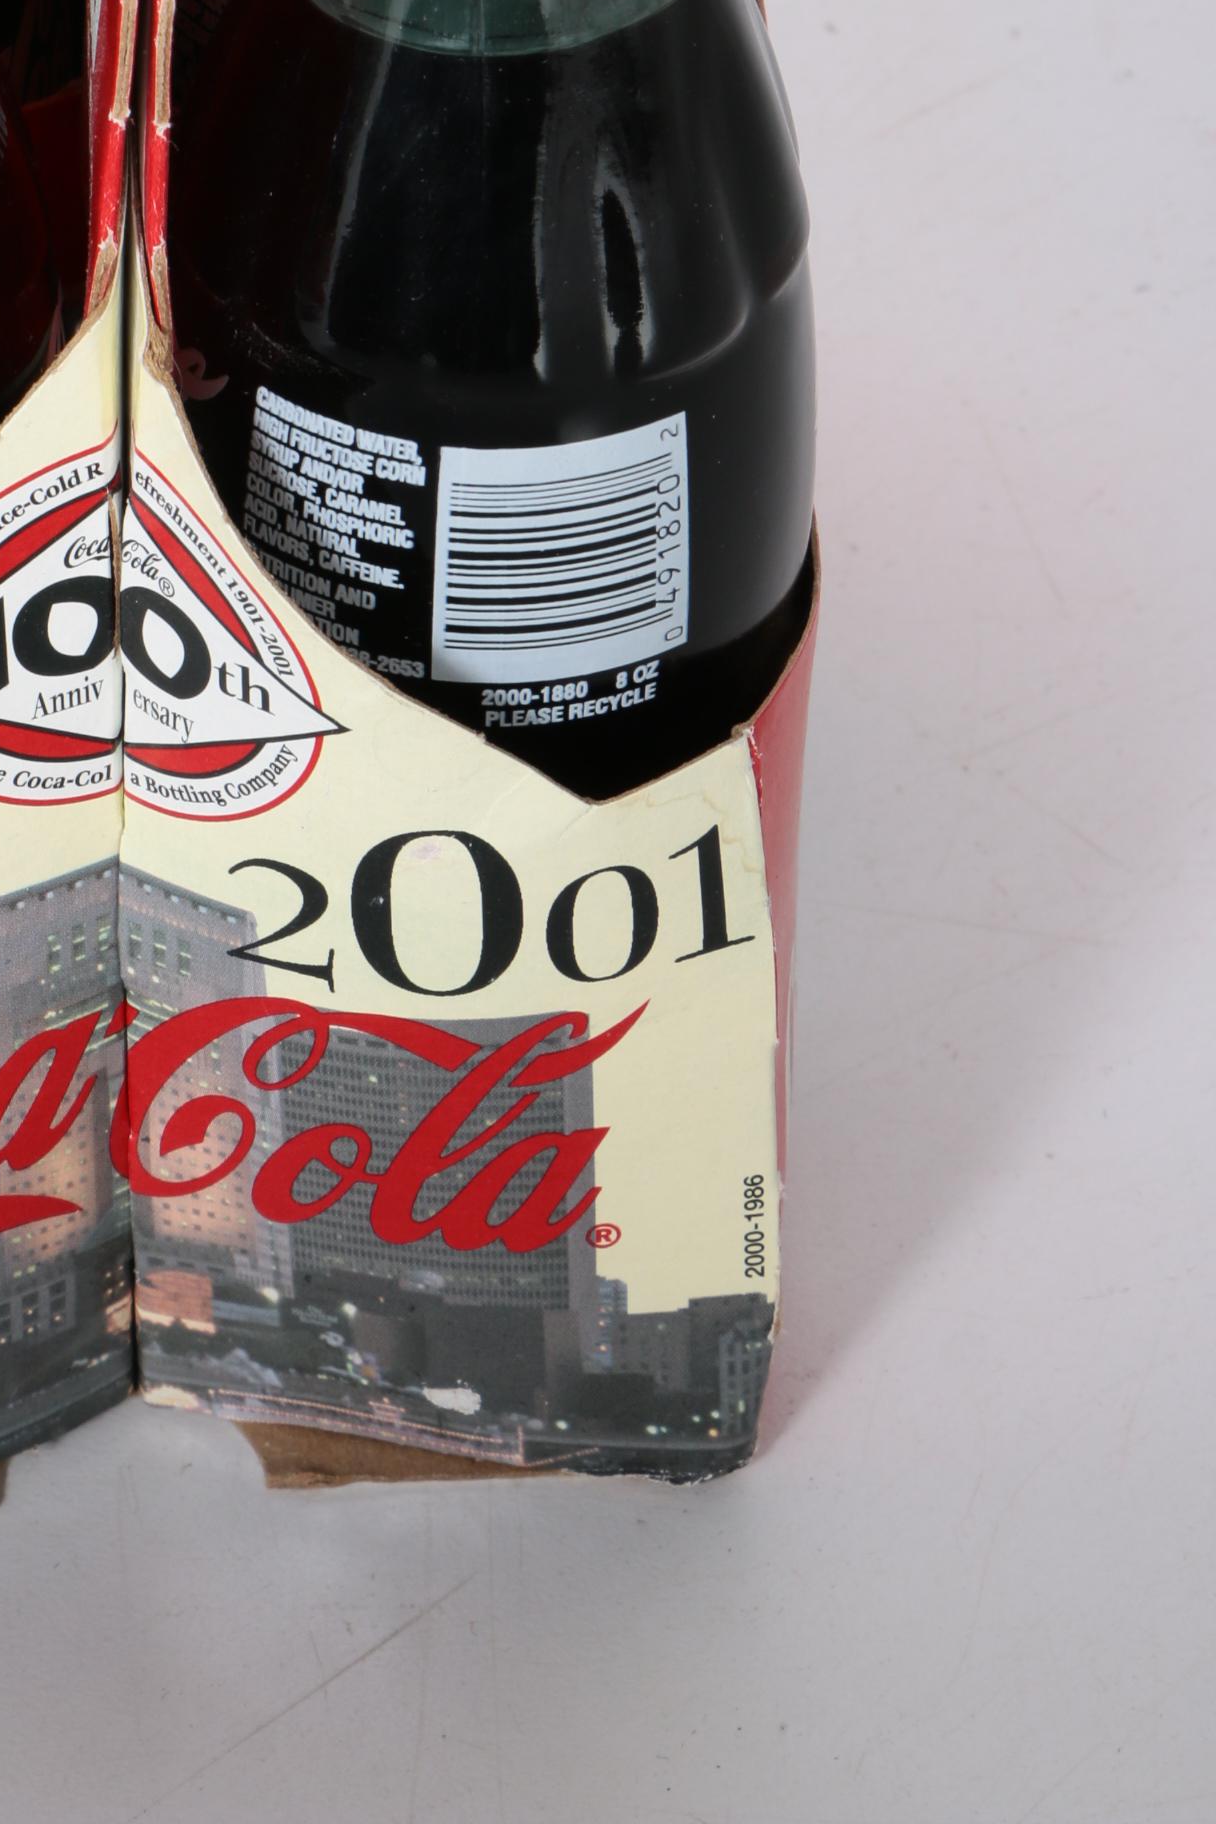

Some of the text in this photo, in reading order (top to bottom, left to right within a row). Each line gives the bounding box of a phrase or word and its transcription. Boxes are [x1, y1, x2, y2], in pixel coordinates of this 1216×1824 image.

[251, 428, 300, 468] SYRUP
[253, 407, 427, 487] HIGH FRUCTOSE CORN
[256, 385, 423, 466] CARBONATED WATER,
[303, 500, 415, 550] PHOSPHORIC
[325, 488, 407, 526] CARAMEL
[285, 518, 361, 558] NATURAL
[318, 549, 405, 590] CAFFEINE.
[335, 583, 377, 611] AND
[227, 578, 295, 678] 1901-2001
[481, 660, 661, 707] 2000-1880 8 OZ
[485, 682, 658, 728] PLEASE RECYCLE
[144, 774, 228, 808] Bottling
[223, 743, 299, 800] Company
[227, 824, 756, 997] 2001
[743, 1174, 766, 1279] 2000-1986
